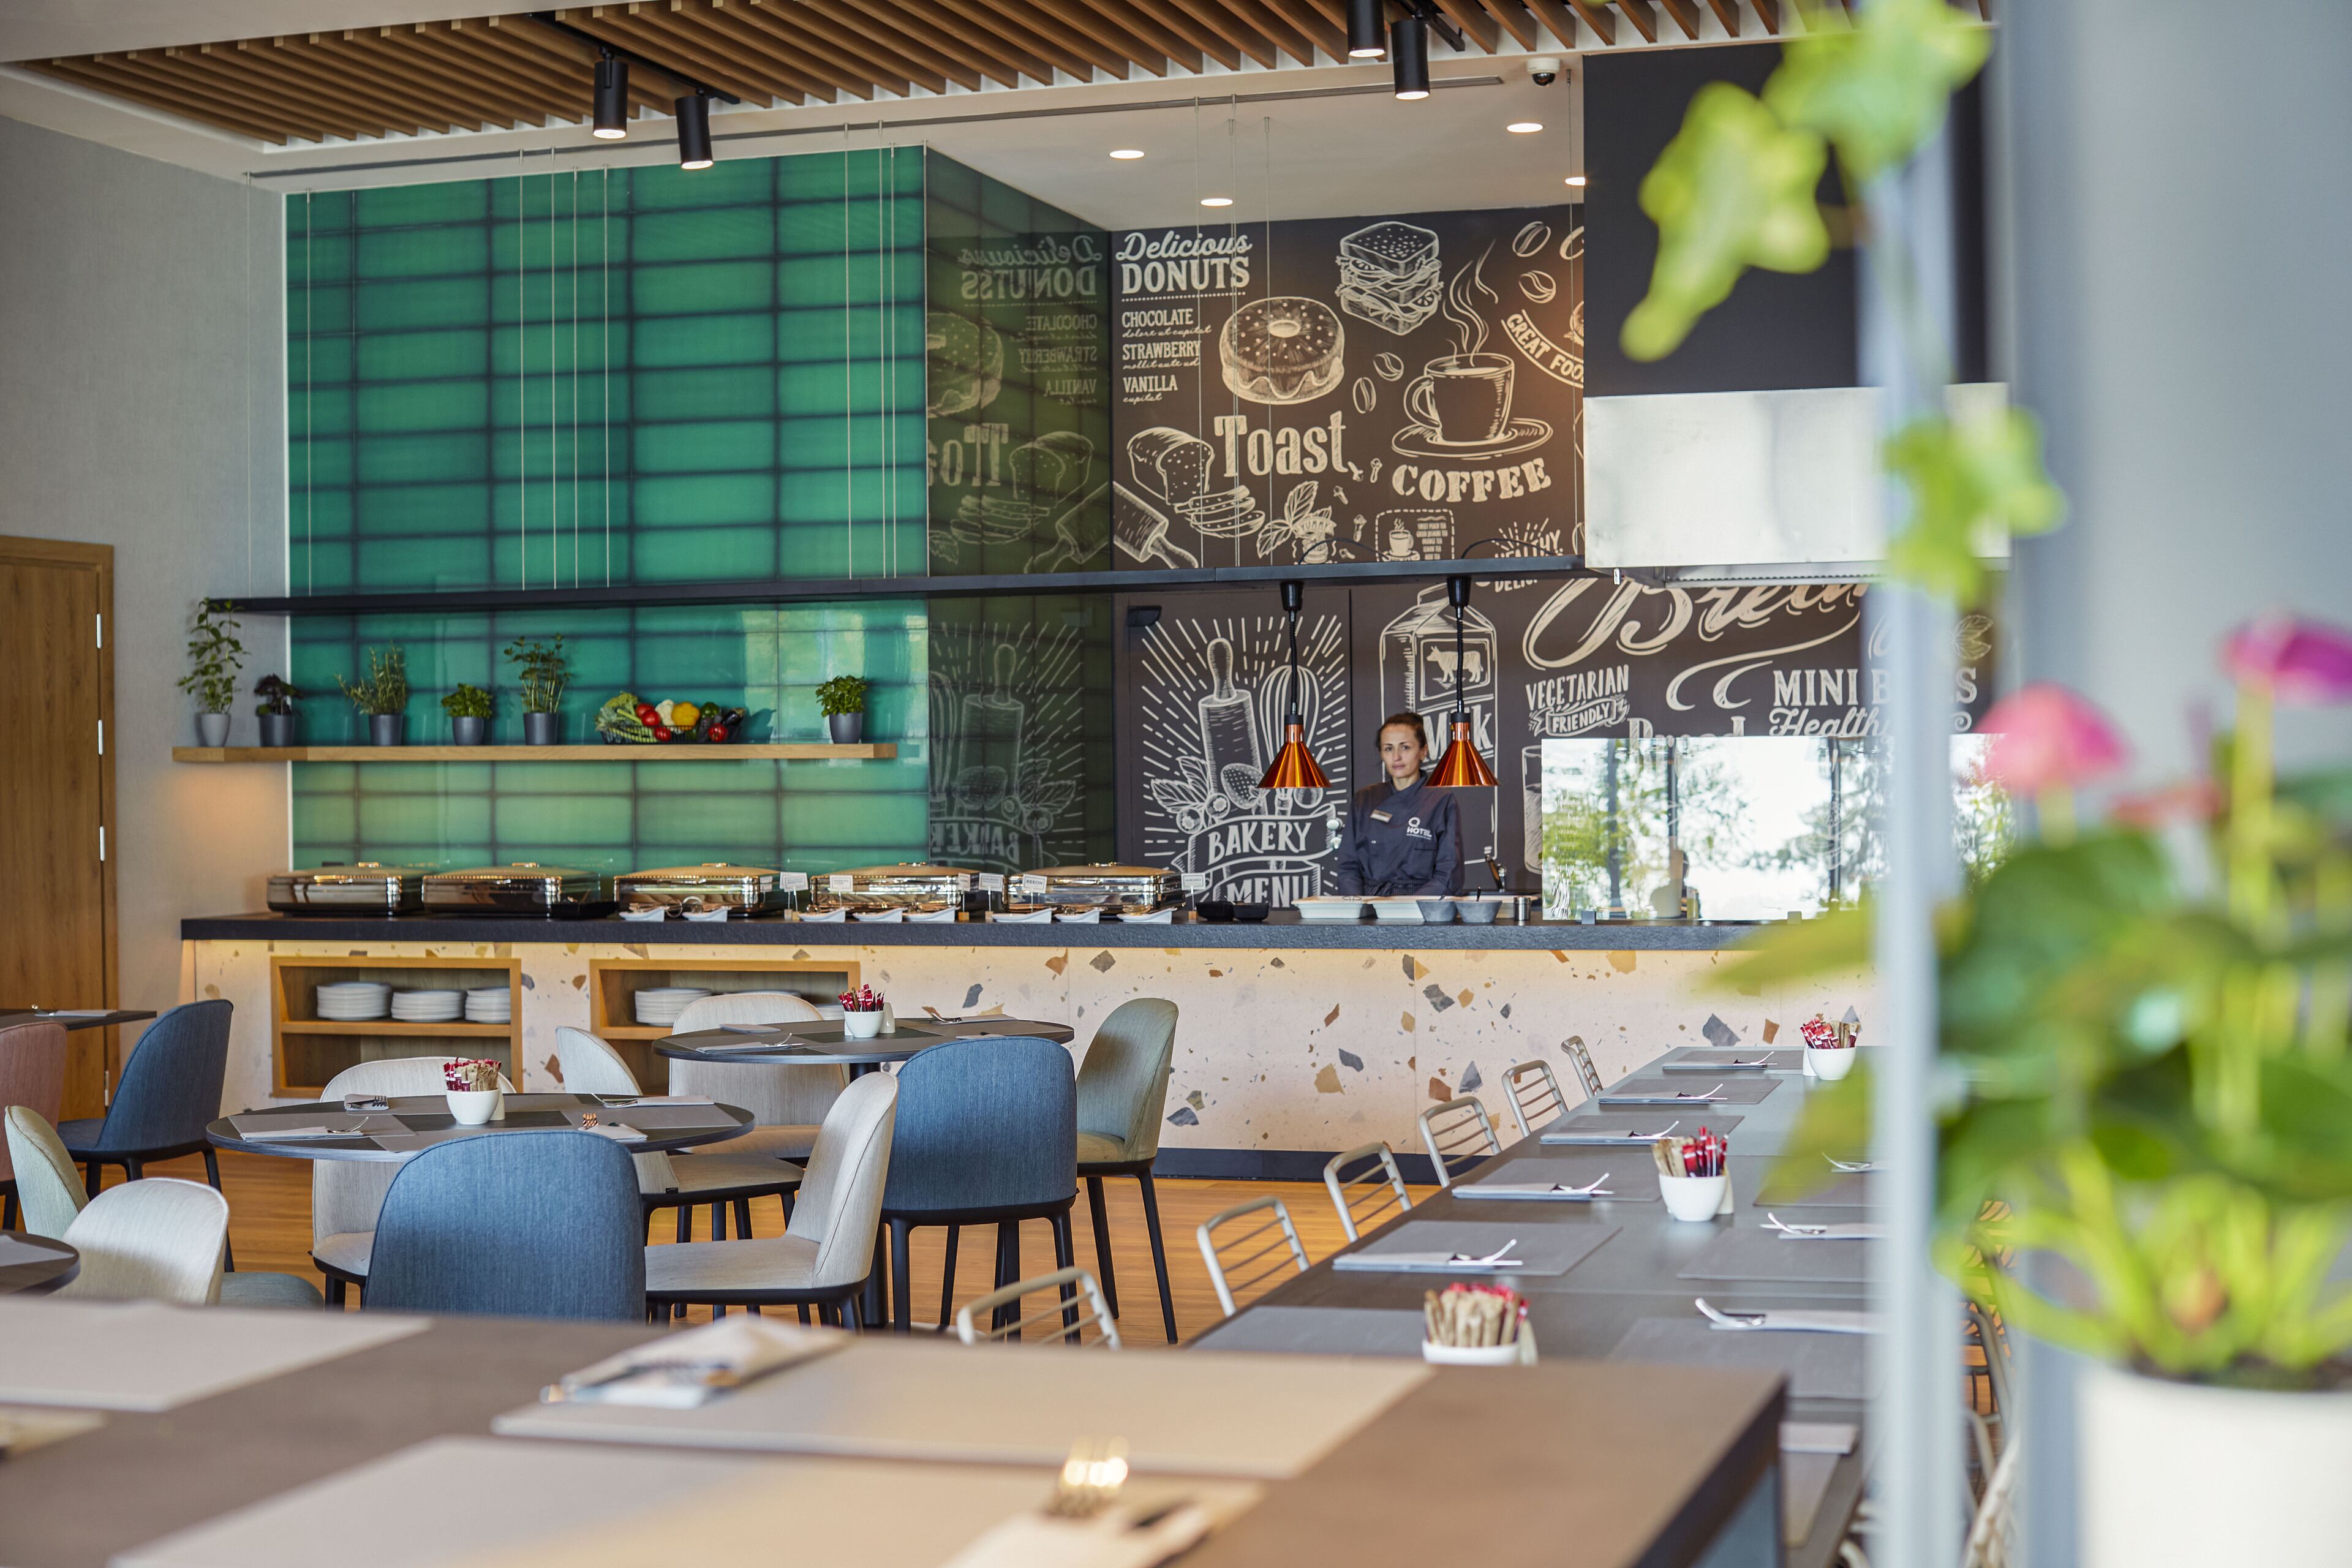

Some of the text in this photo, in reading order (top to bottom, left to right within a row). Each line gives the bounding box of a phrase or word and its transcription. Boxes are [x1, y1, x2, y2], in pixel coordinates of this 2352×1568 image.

[1115, 230, 1253, 261] Delicious
[1121, 256, 1251, 294] DONUTS
[1121, 308, 1194, 328] CHOCOLATE
[1122, 340, 1202, 361] STRAWBERRY
[1123, 374, 1178, 393] VANILLA
[1549, 354, 1585, 383] FOO
[1214, 410, 1349, 477] Toast
[1392, 458, 1552, 503] COFFEE
[1525, 664, 1629, 711] VEGETARIAN
[1773, 668, 1859, 707] MINI
[1552, 702, 1611, 734] FRIENDLY
[1208, 821, 1313, 865] BAKERY
[1406, 826, 1433, 838] HOTEL
[1226, 875, 1310, 908] MENU
